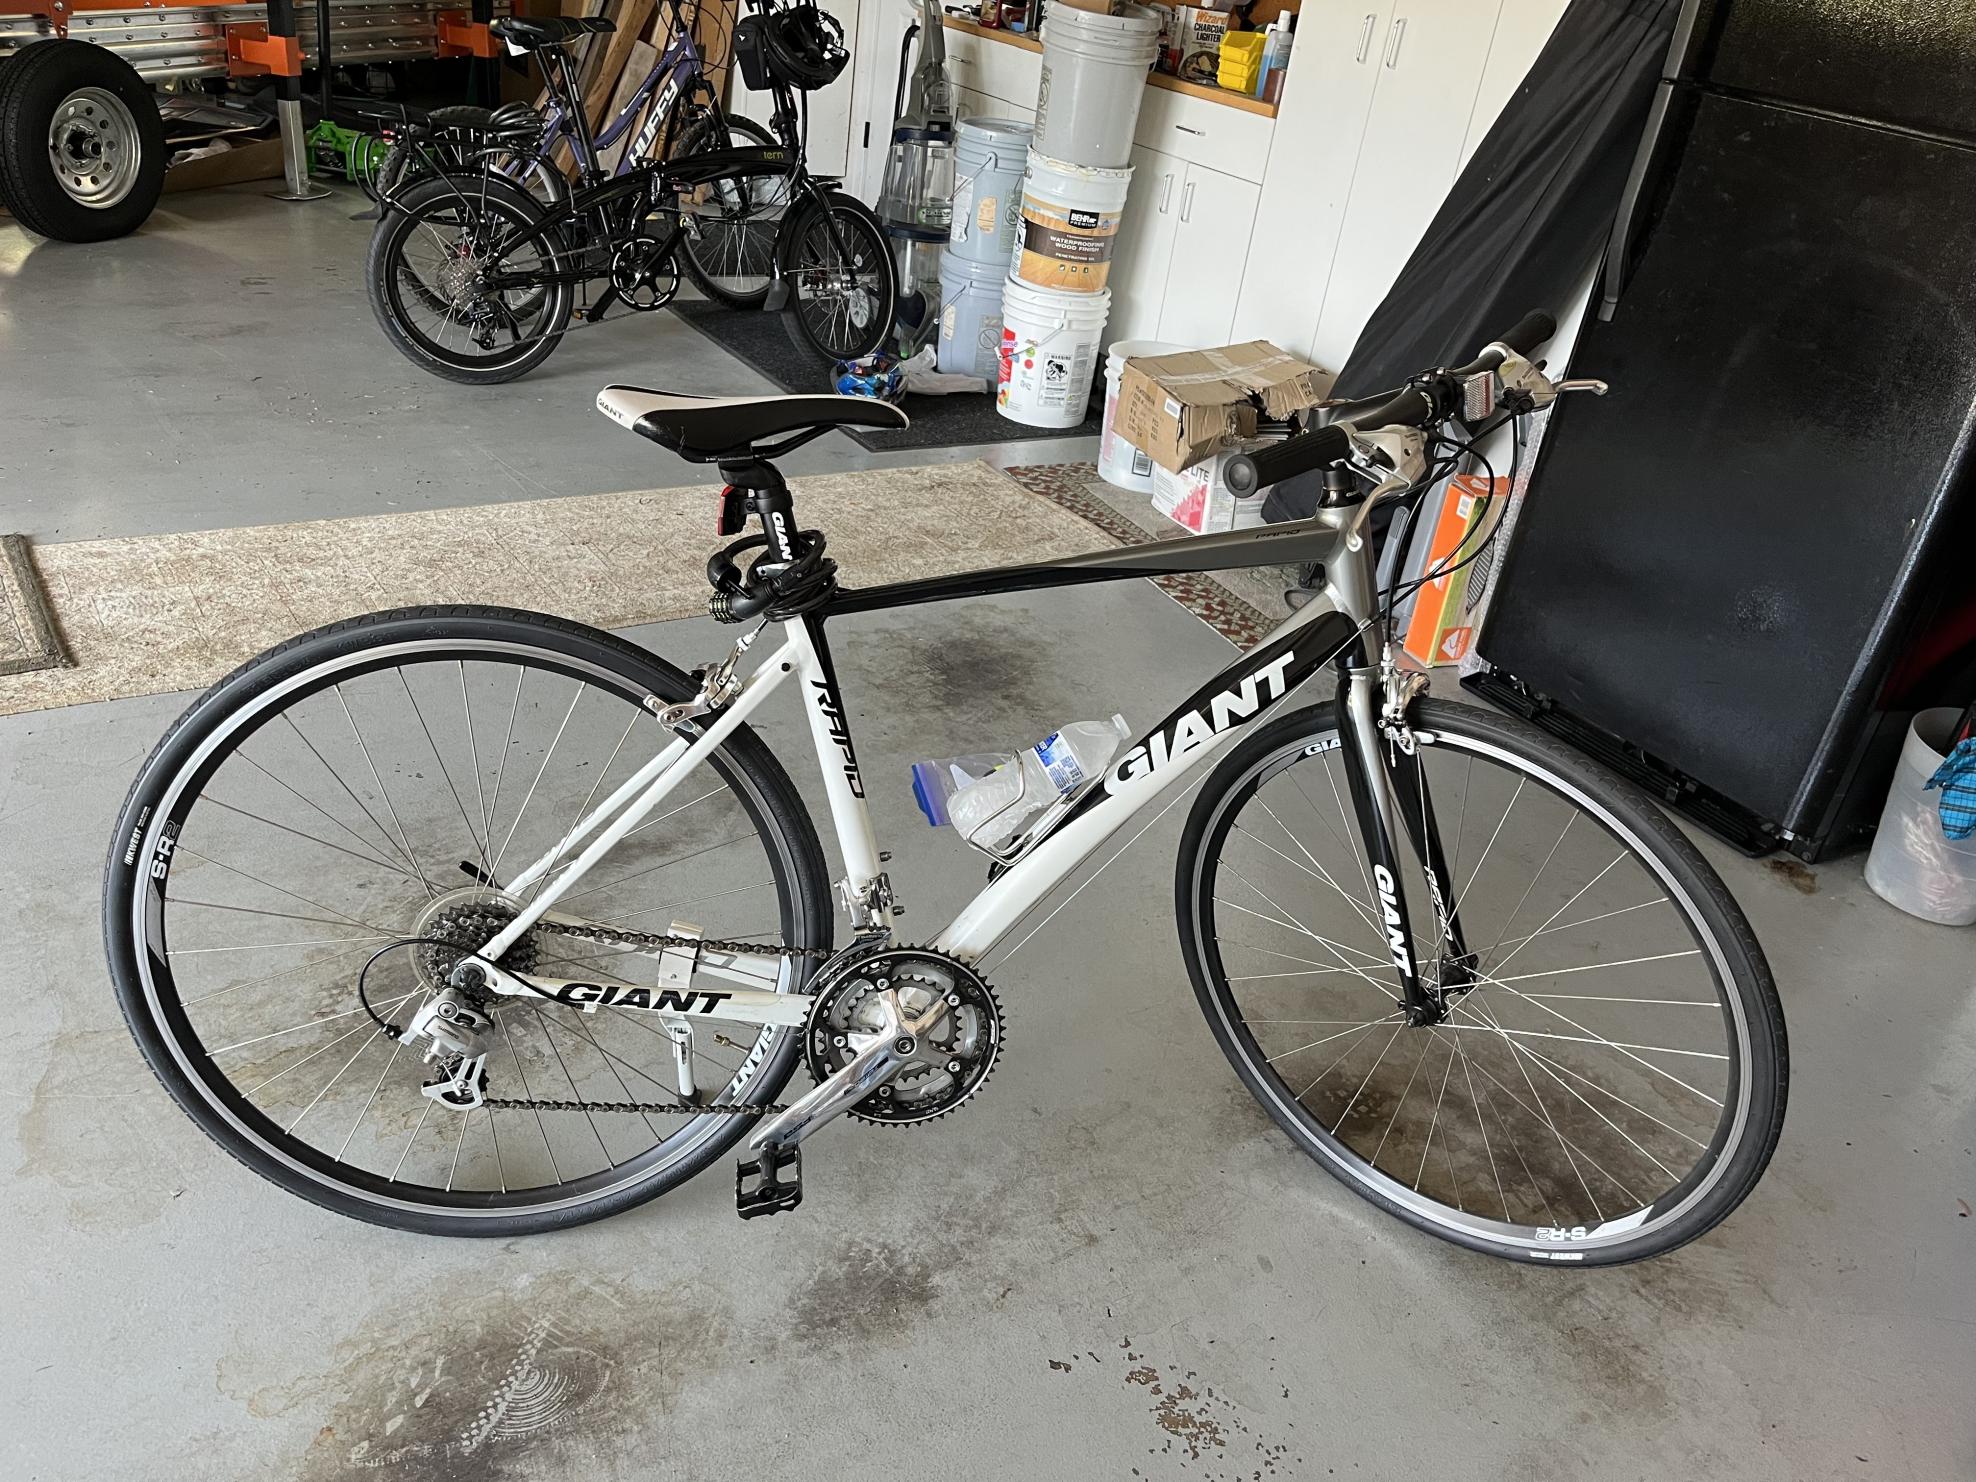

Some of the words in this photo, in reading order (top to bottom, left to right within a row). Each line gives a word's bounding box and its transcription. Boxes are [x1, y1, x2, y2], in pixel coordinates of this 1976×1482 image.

[1196, 10, 1228, 26] Wizard
[1193, 22, 1226, 35] CHARCOAL
[1196, 32, 1221, 43] LIGHTER
[628, 78, 679, 167] HUFFY
[763, 151, 784, 160] tern
[1070, 213, 1091, 224] BEHR
[1050, 236, 1104, 248] WATERPROOFING
[1055, 242, 1077, 251] WOOD
[598, 398, 624, 420] GIANT
[1191, 465, 1210, 482] LITE
[771, 511, 793, 561] GIAN
[1103, 650, 1295, 796] GIANT
[810, 680, 865, 799] RAPID
[1304, 738, 1342, 756] GIA
[1373, 864, 1413, 978] GIANT
[556, 982, 733, 1014] GIANT
[732, 1023, 778, 1097] GIANT
